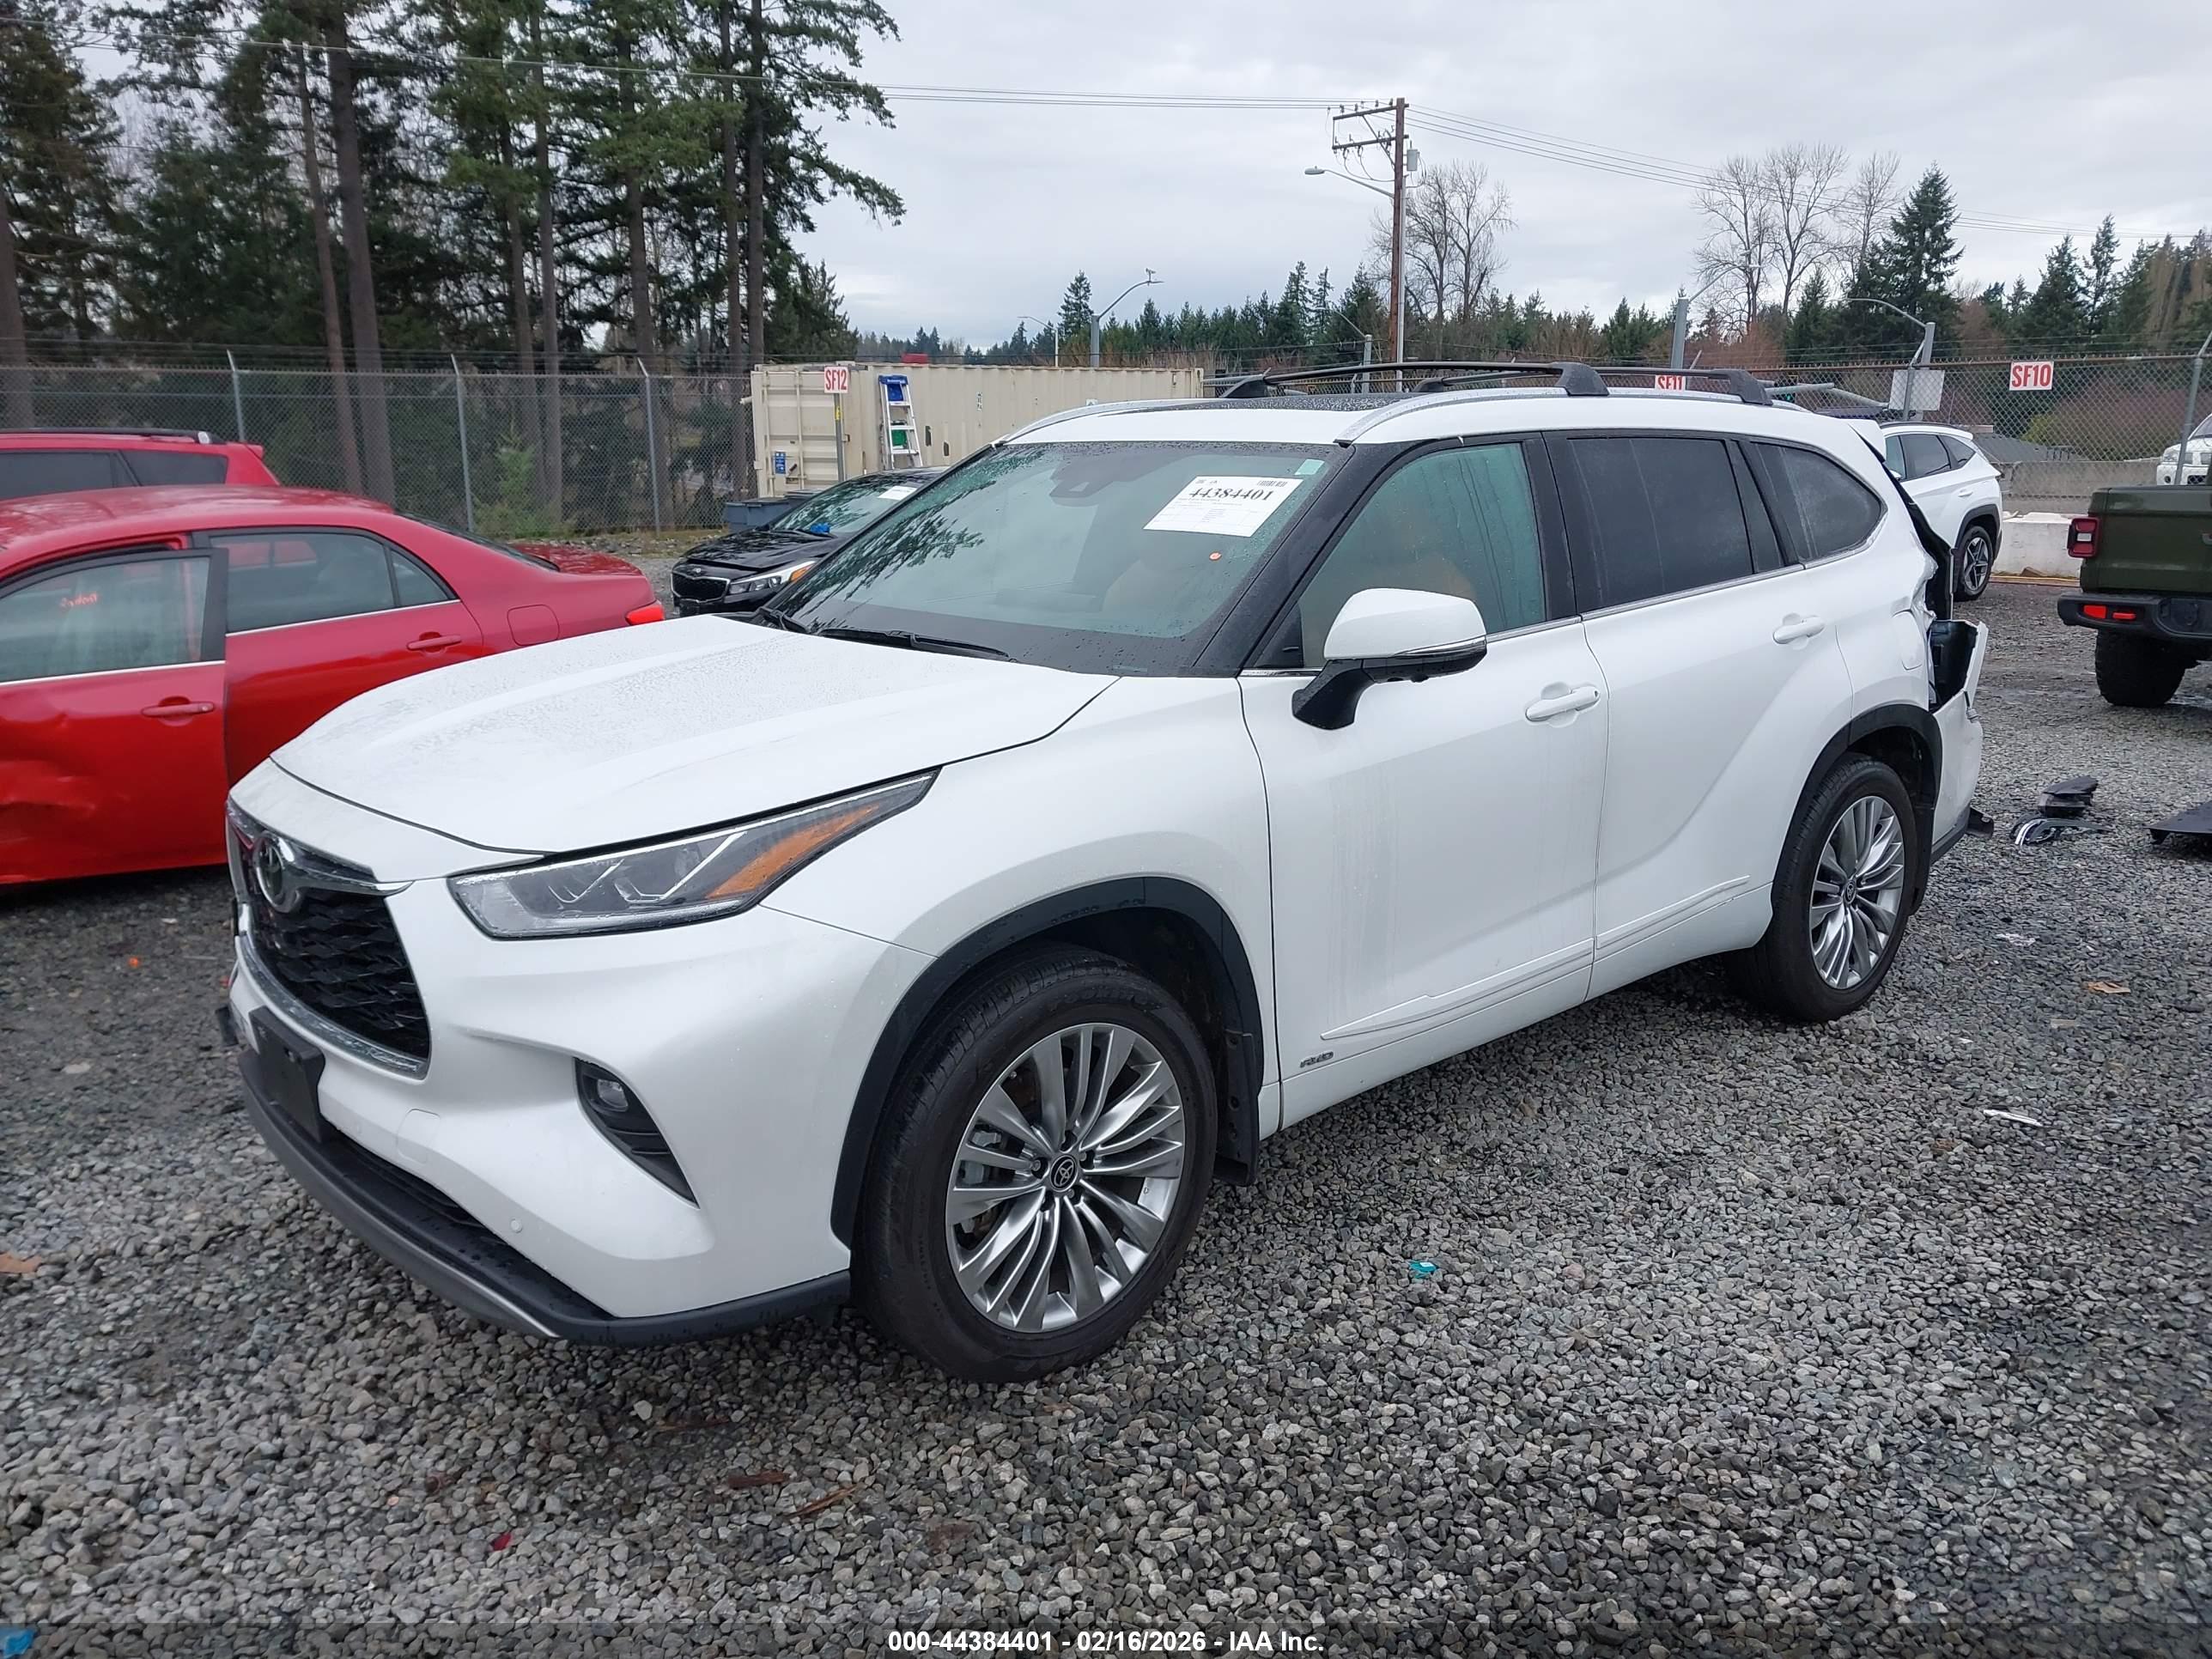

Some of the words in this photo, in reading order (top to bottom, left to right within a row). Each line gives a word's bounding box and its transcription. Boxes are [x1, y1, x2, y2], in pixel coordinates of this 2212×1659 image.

[825, 369, 847, 390] SF12
[2012, 364, 2051, 387] SF10
[1189, 487, 1273, 501] 44384401
